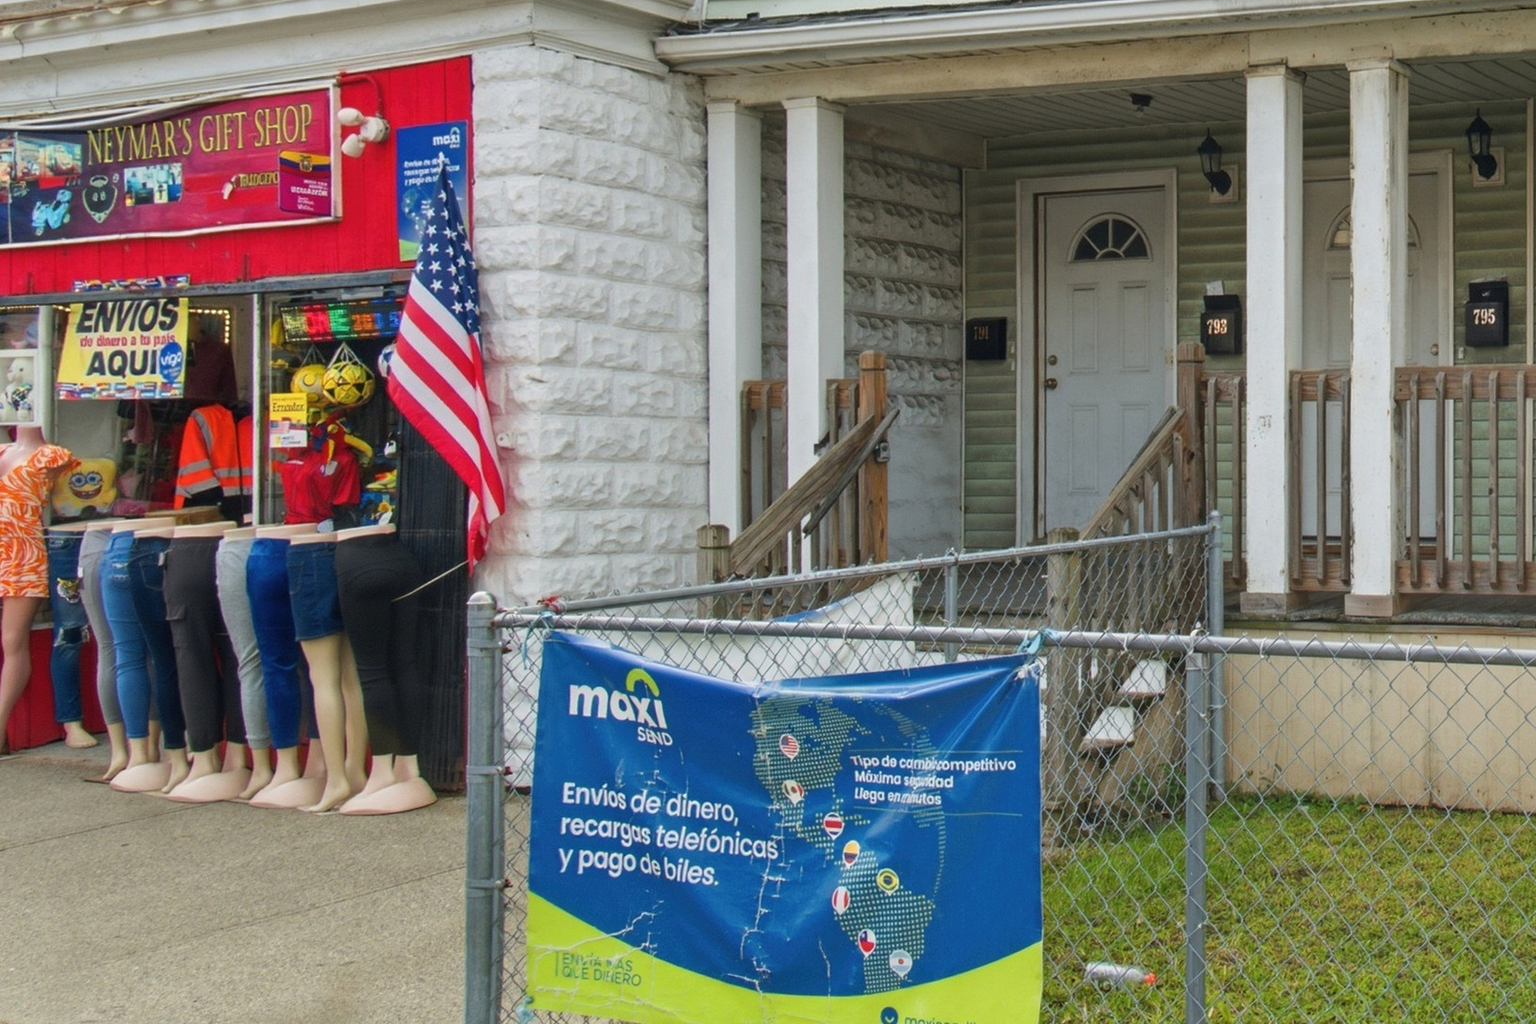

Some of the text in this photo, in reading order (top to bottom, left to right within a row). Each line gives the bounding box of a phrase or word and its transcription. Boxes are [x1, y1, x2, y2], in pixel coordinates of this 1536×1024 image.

[87, 103, 312, 165] NEYMAR'S GIFT SHOP
[75, 297, 180, 333] ENVIOS
[1207, 319, 1227, 334] 793
[1473, 308, 1495, 325] 795
[85, 349, 157, 379] AQUI
[569, 684, 667, 729] maxi
[637, 726, 673, 746] SEND
[850, 755, 879, 769] Tipo
[882, 755, 897, 767] de
[562, 782, 738, 826] Envíos de dinero,
[854, 787, 885, 804] Llega
[560, 816, 778, 859] recargas telefónicas
[559, 848, 719, 886] y pago de biles.
